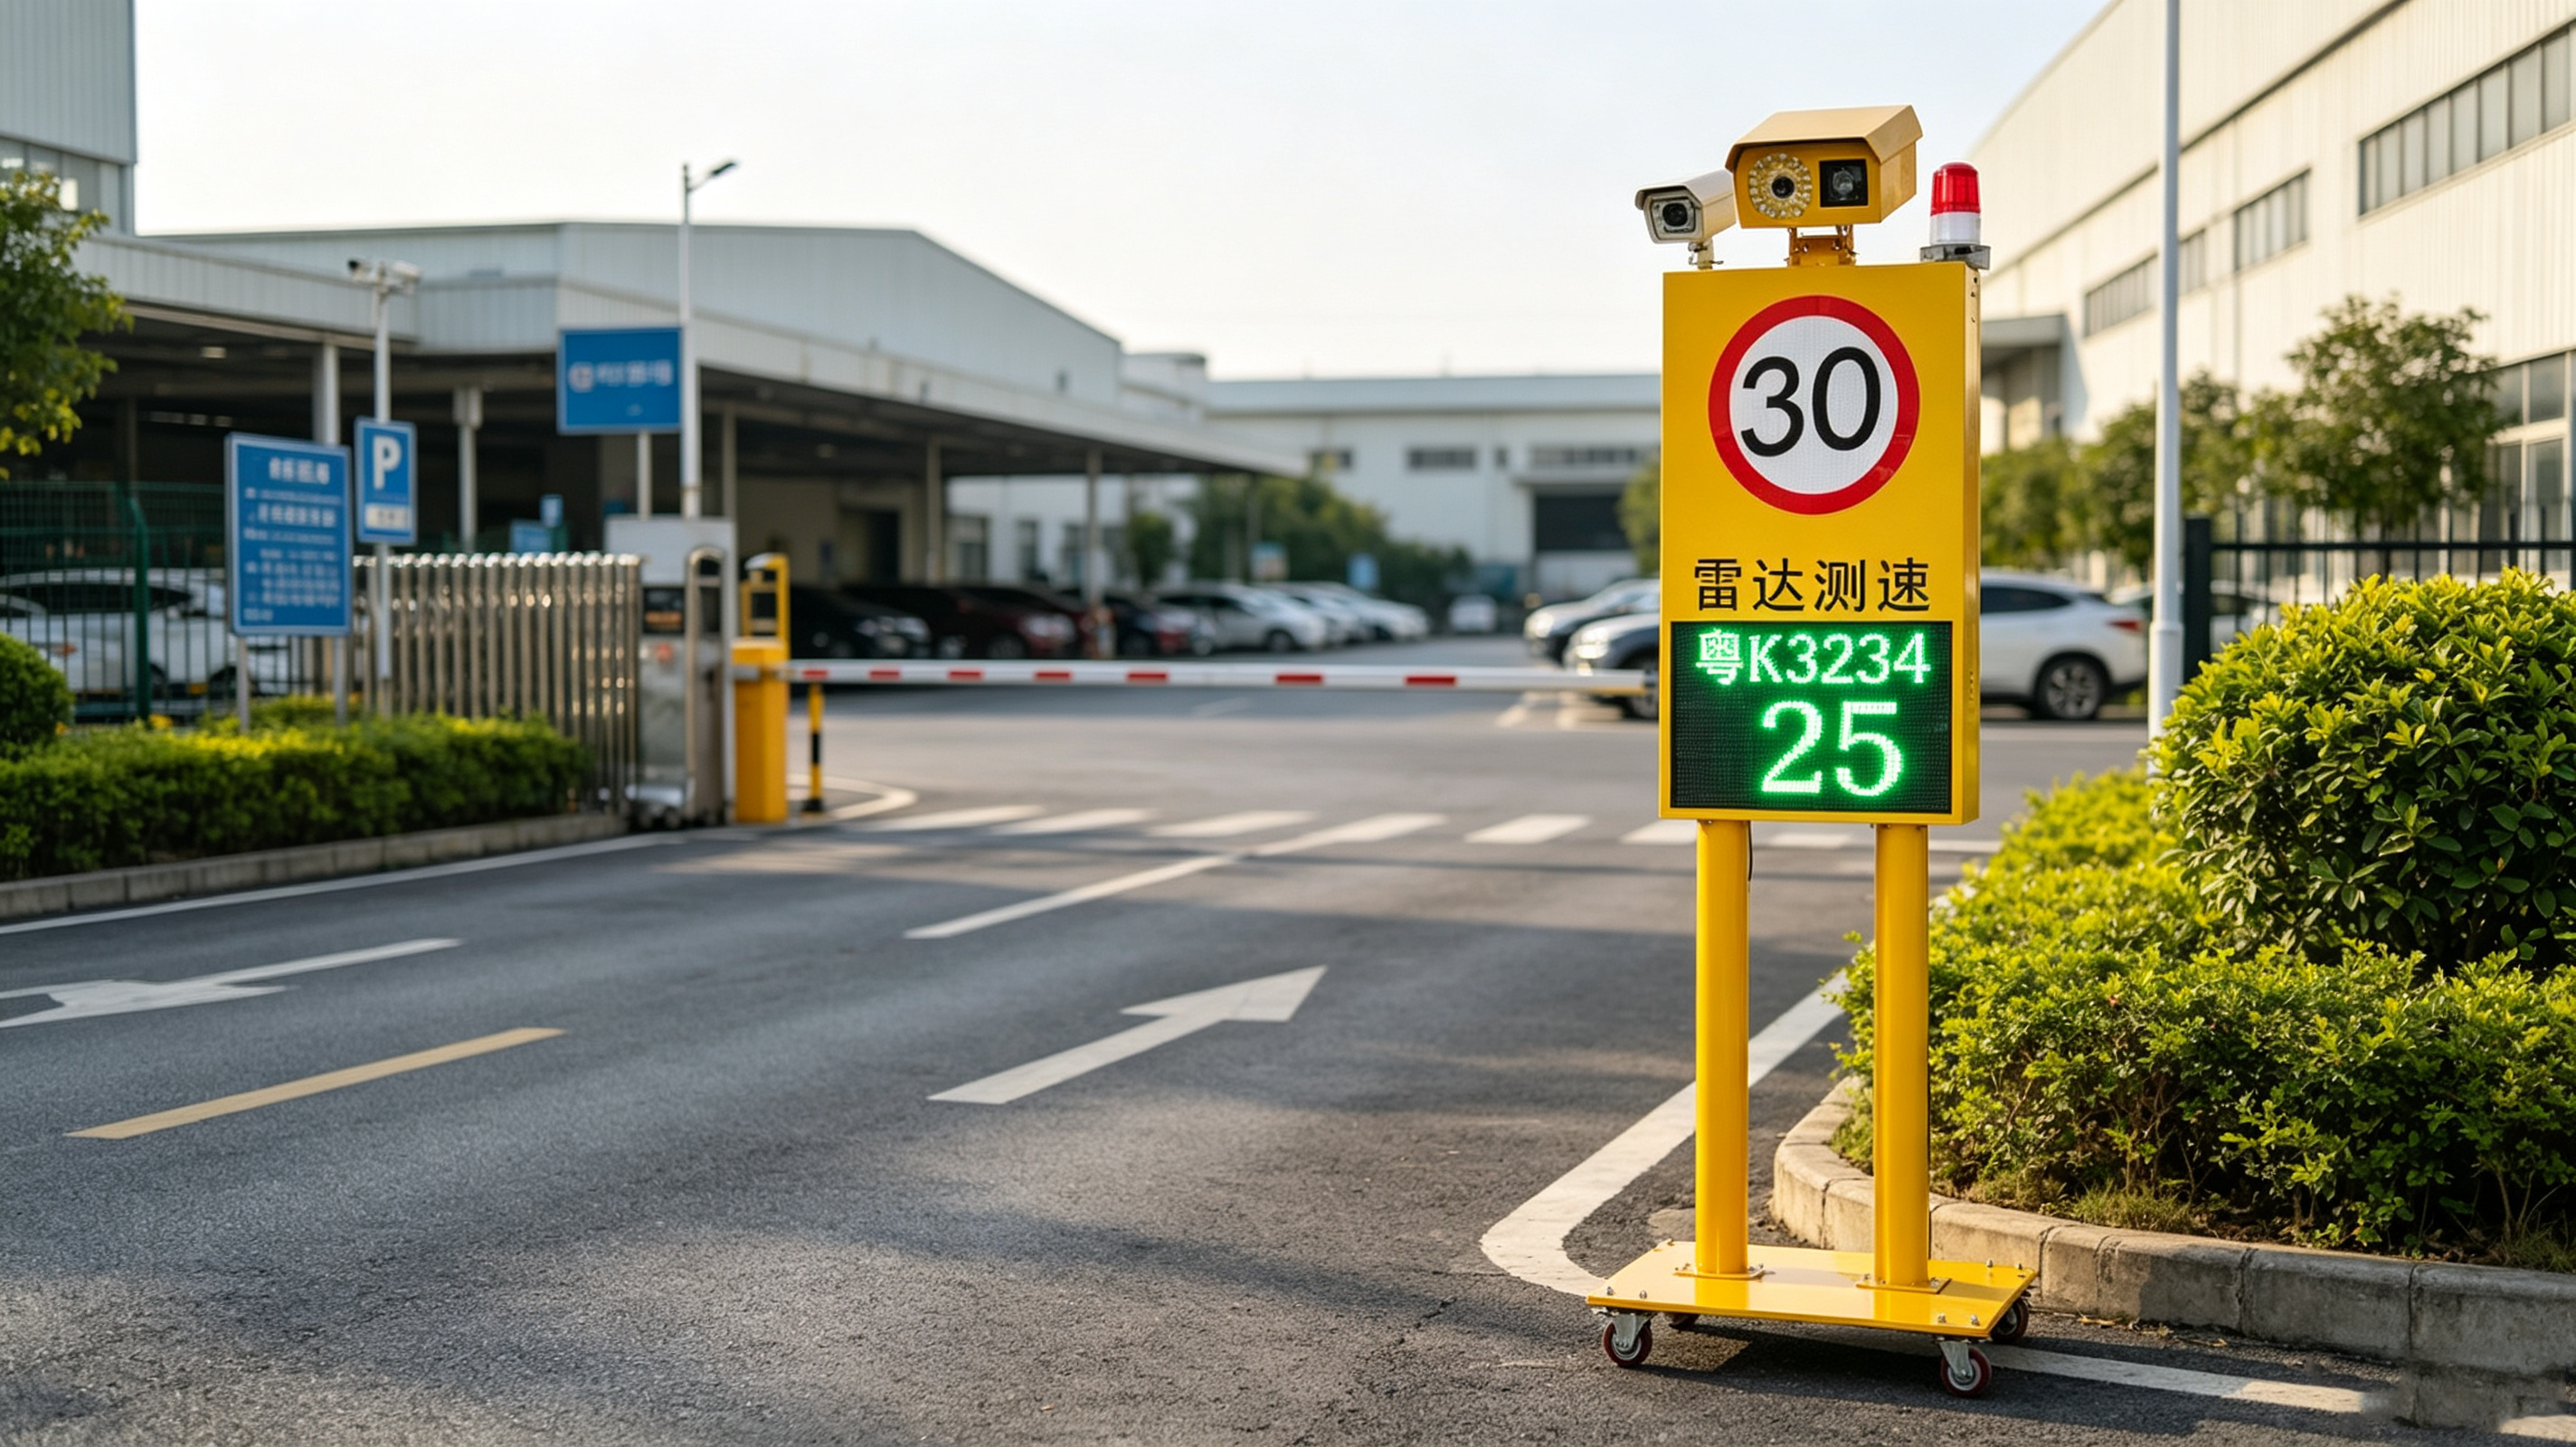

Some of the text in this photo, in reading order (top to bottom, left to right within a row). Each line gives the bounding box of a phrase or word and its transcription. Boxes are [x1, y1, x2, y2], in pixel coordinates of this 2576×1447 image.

[1740, 346, 1881, 458] 30
[373, 435, 402, 489] P
[1694, 557, 1931, 612] 雷达测速
[1695, 628, 1931, 687] 粤K3234
[1759, 699, 1905, 799] 25
